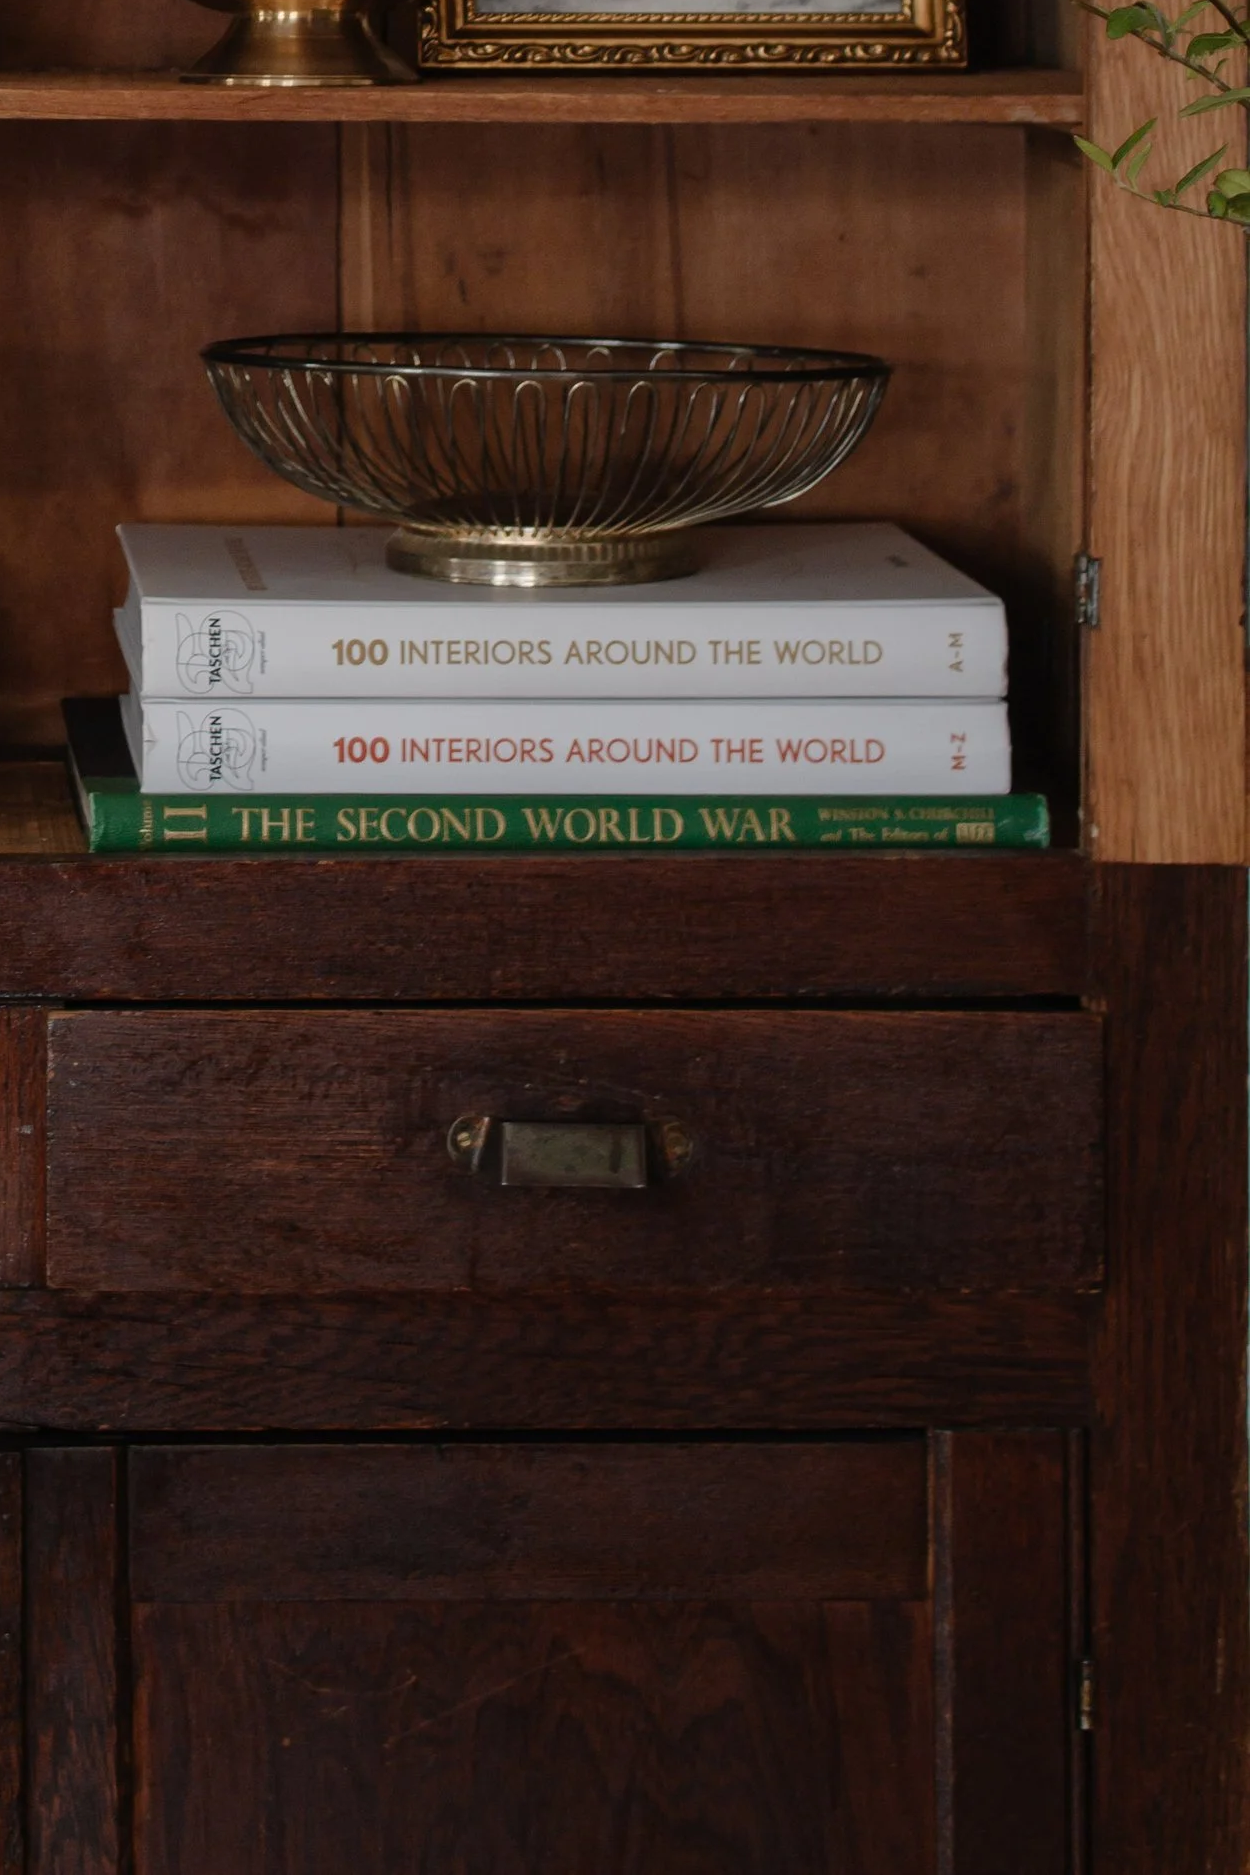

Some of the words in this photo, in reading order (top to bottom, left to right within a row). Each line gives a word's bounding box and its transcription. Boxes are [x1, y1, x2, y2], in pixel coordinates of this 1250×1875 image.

[208, 618, 222, 685] TASCHEN
[332, 638, 389, 666] 100
[400, 639, 553, 666] INTERIORS
[564, 639, 697, 666] AROUND
[709, 639, 762, 665] THE
[773, 639, 883, 666] WORLD
[948, 633, 964, 673] A-M
[210, 716, 223, 781] TASCHEN
[333, 736, 390, 764] 100
[401, 737, 554, 764] INTERIORS
[565, 737, 698, 764] AROUND
[710, 737, 763, 763] THE
[774, 737, 884, 764] WORLD
[950, 732, 967, 771] M-Z
[163, 804, 208, 843] II
[232, 807, 316, 842] THE
[336, 806, 507, 843] SECOND
[521, 807, 685, 843] WORLD
[699, 807, 796, 843] WAR
